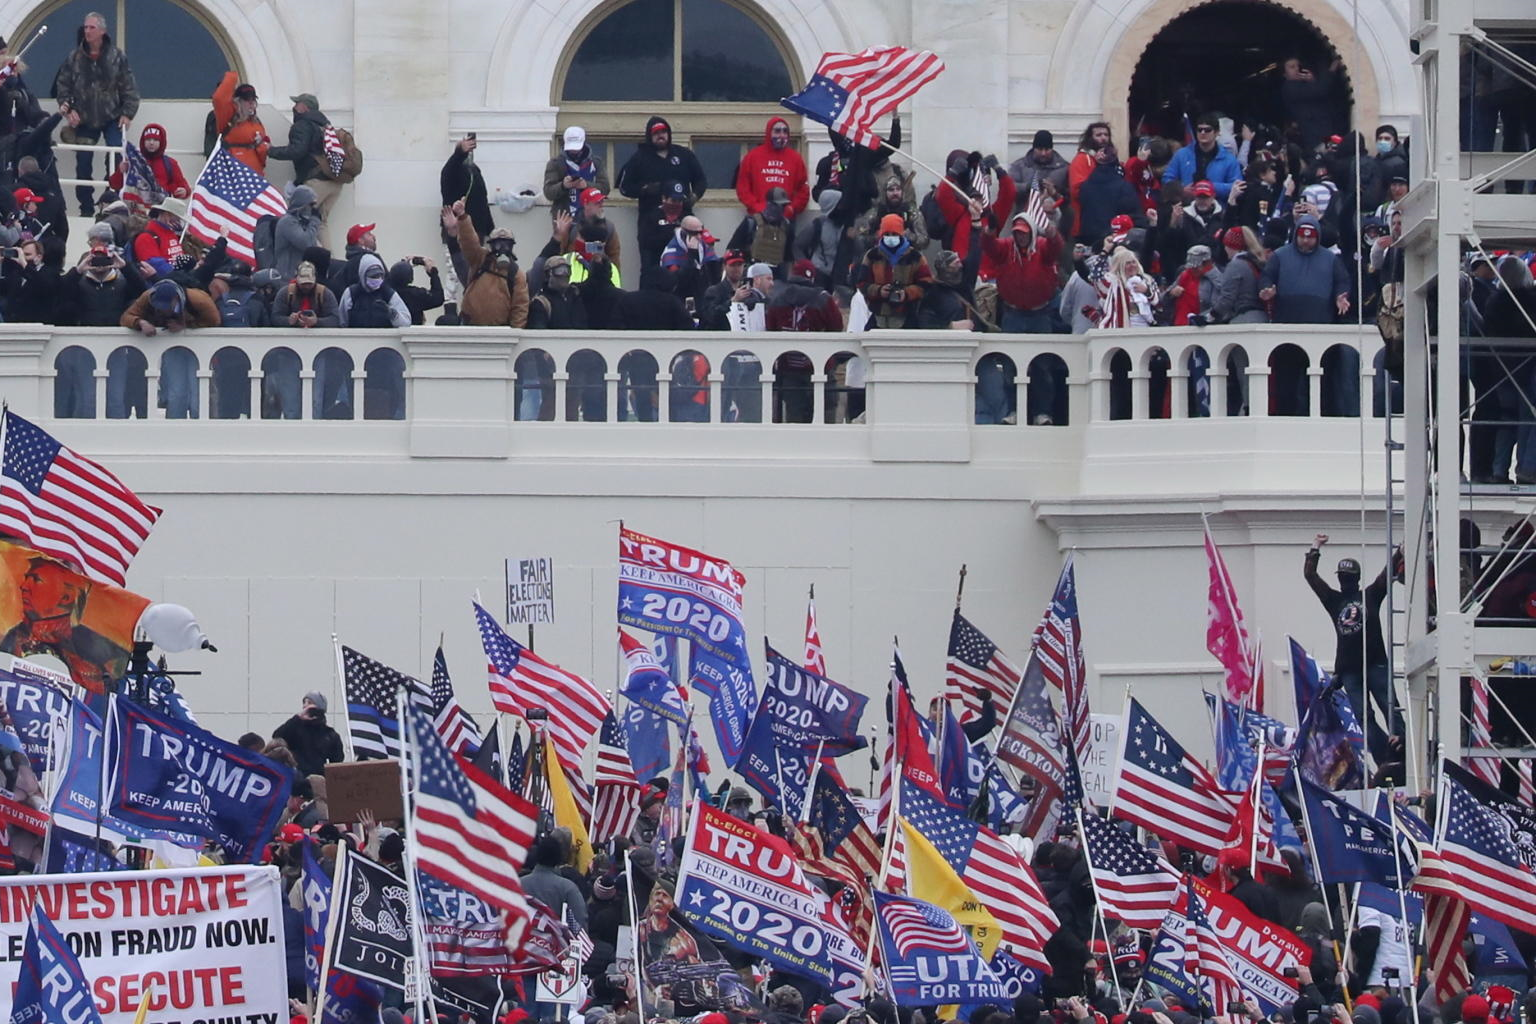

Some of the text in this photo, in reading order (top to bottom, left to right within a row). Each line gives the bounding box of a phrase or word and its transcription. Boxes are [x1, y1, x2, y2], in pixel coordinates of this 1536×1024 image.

[761, 167, 790, 176] AMERICA
[520, 558, 546, 582] FAIR
[621, 537, 743, 596] TRUMP
[621, 565, 657, 580] KEEP
[658, 573, 716, 598] AMERICA
[509, 581, 552, 605] ELECTIONS
[509, 604, 549, 623] MATTER
[642, 593, 730, 642] 2020
[695, 661, 723, 682] KEEP
[136, 723, 272, 804] TRUMP
[69, 789, 97, 810] KEEP
[129, 791, 161, 809] KEEP
[705, 812, 758, 841] Re-Elect
[696, 859, 800, 911] KEEP AMERICA
[111, 924, 197, 957] FRAUD
[205, 917, 276, 948] NOW.
[684, 910, 702, 923] For
[736, 933, 748, 944] Of
[751, 937, 769, 951] The
[773, 949, 805, 966] United
[710, 889, 823, 957] 2020
[12, 966, 246, 1016] SECUTE
[920, 983, 962, 1000] FOR
